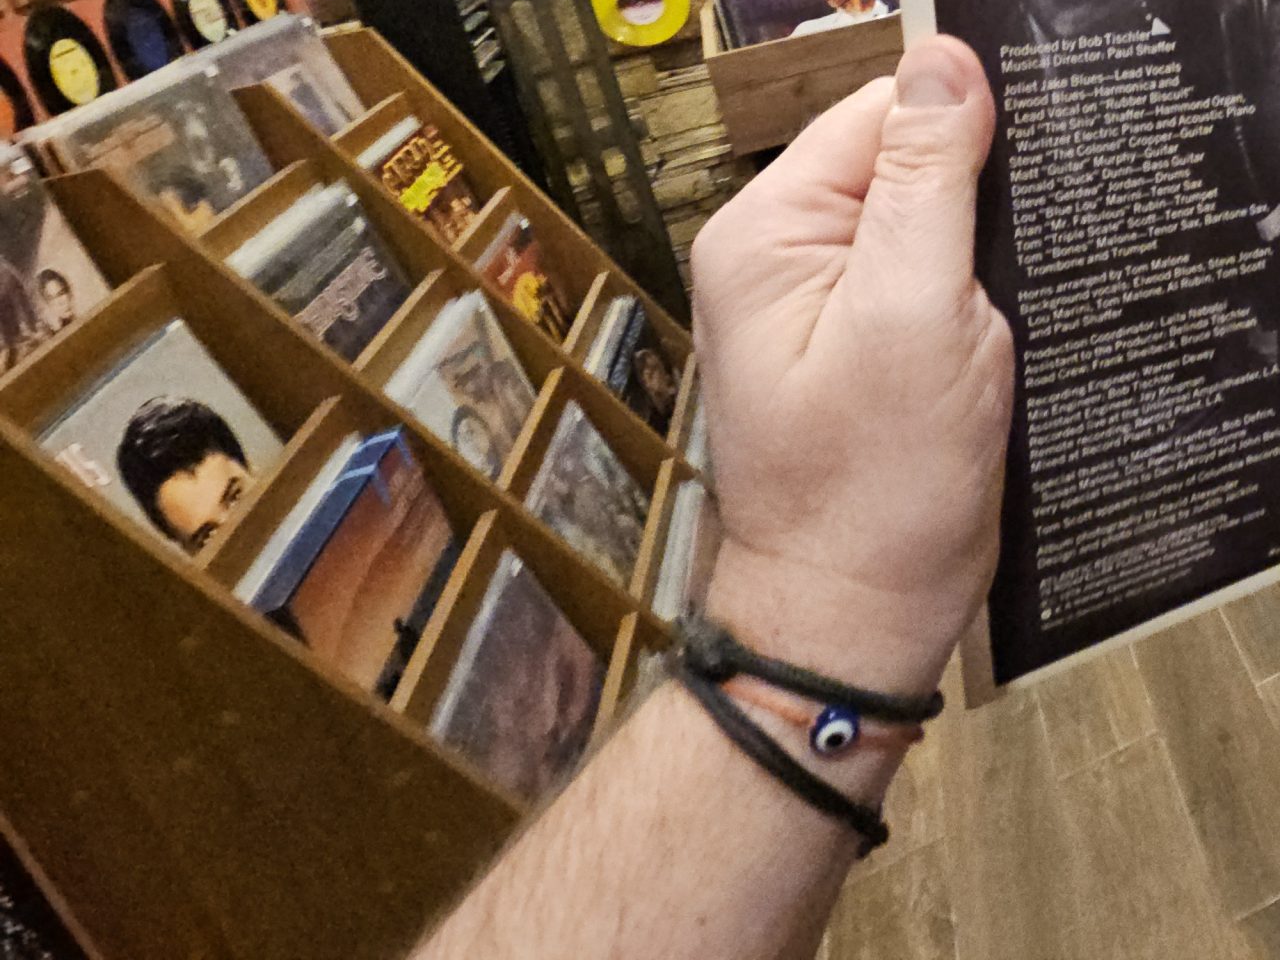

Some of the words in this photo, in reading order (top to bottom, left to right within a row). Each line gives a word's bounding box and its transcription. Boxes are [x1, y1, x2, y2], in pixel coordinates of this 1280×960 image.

[1062, 41, 1075, 53] by
[1079, 38, 1103, 50] Bob
[1107, 47, 1133, 60] Paul
[1159, 77, 1181, 90] and
[1015, 111, 1046, 125] Lead
[1083, 104, 1098, 115] on
[1122, 124, 1155, 136] Piano
[1156, 118, 1178, 131] and
[1227, 107, 1257, 119] Piano
[1087, 252, 1110, 265] and
